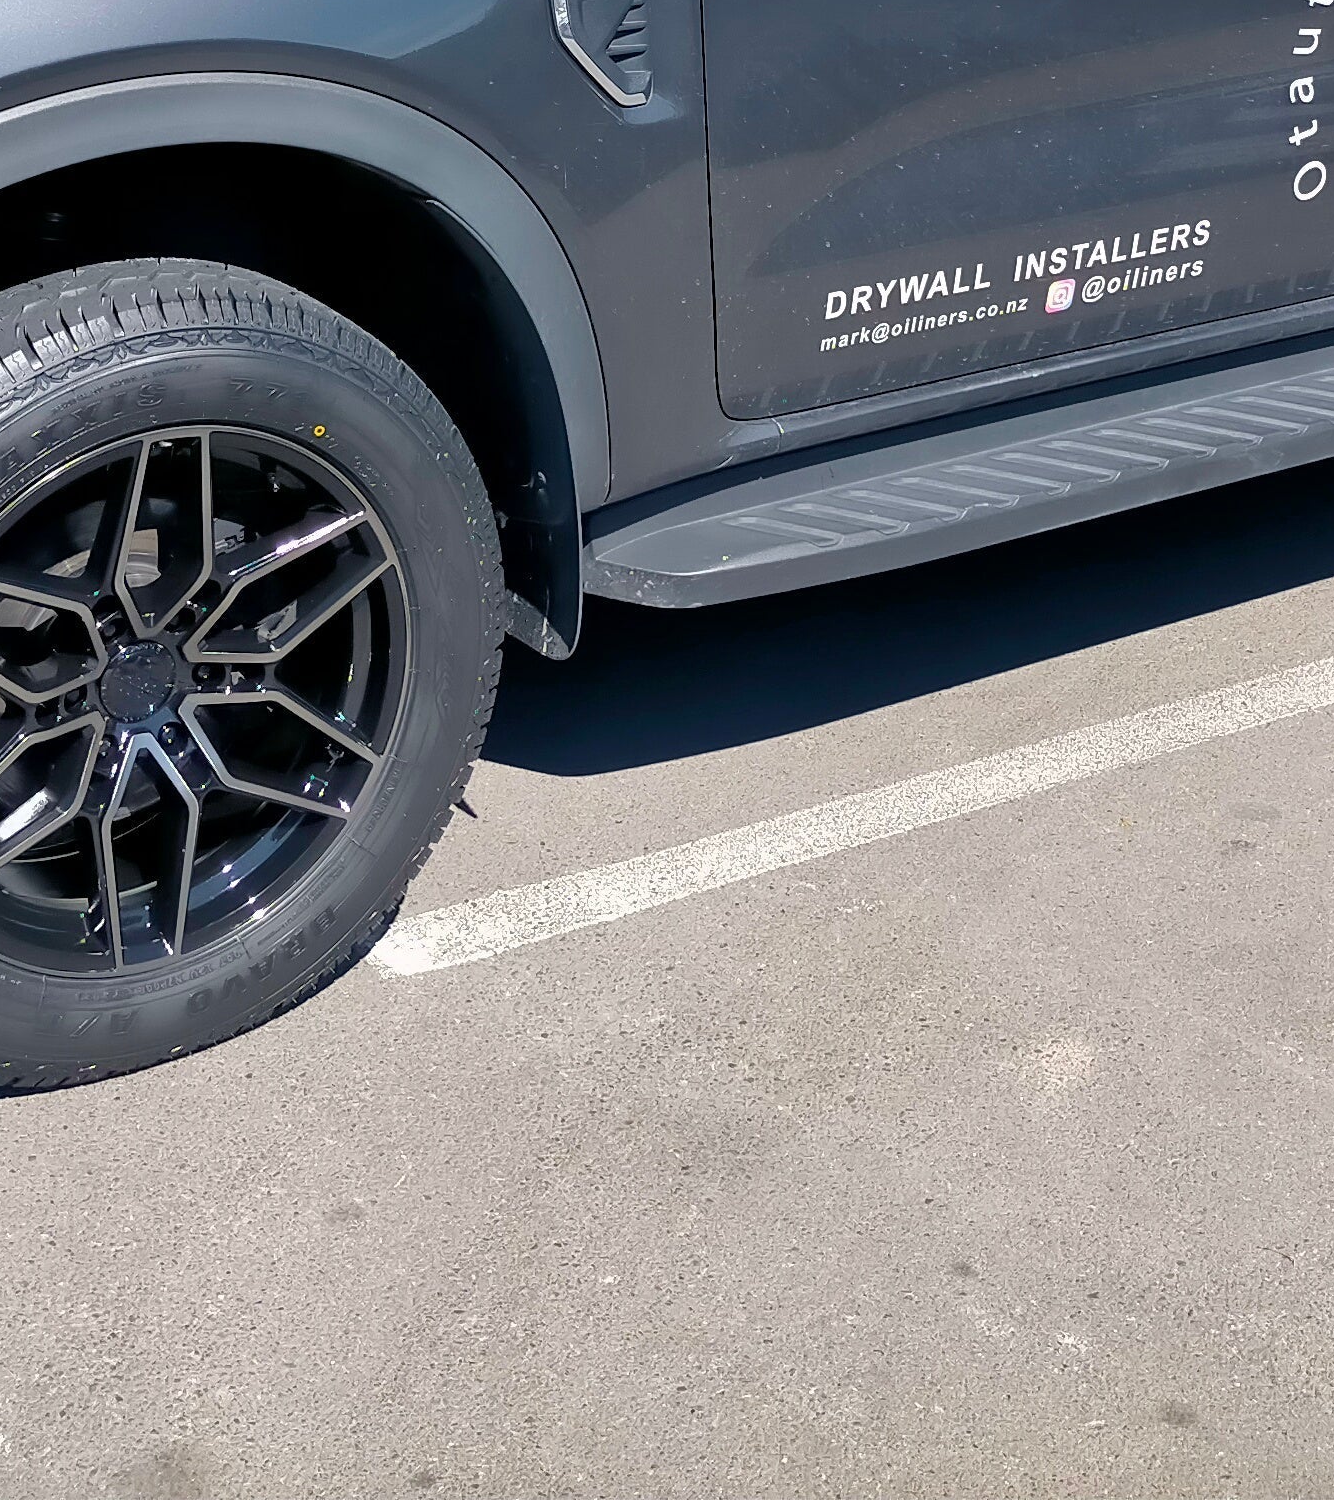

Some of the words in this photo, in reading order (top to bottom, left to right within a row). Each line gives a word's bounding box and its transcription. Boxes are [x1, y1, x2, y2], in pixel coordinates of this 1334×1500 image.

[819, 296, 1028, 352] mark@oiliners.co.nz
[1081, 258, 1204, 303] @oiliners
[824, 262, 991, 320] DRYWALL
[1013, 219, 1212, 282] INSTALLERS
